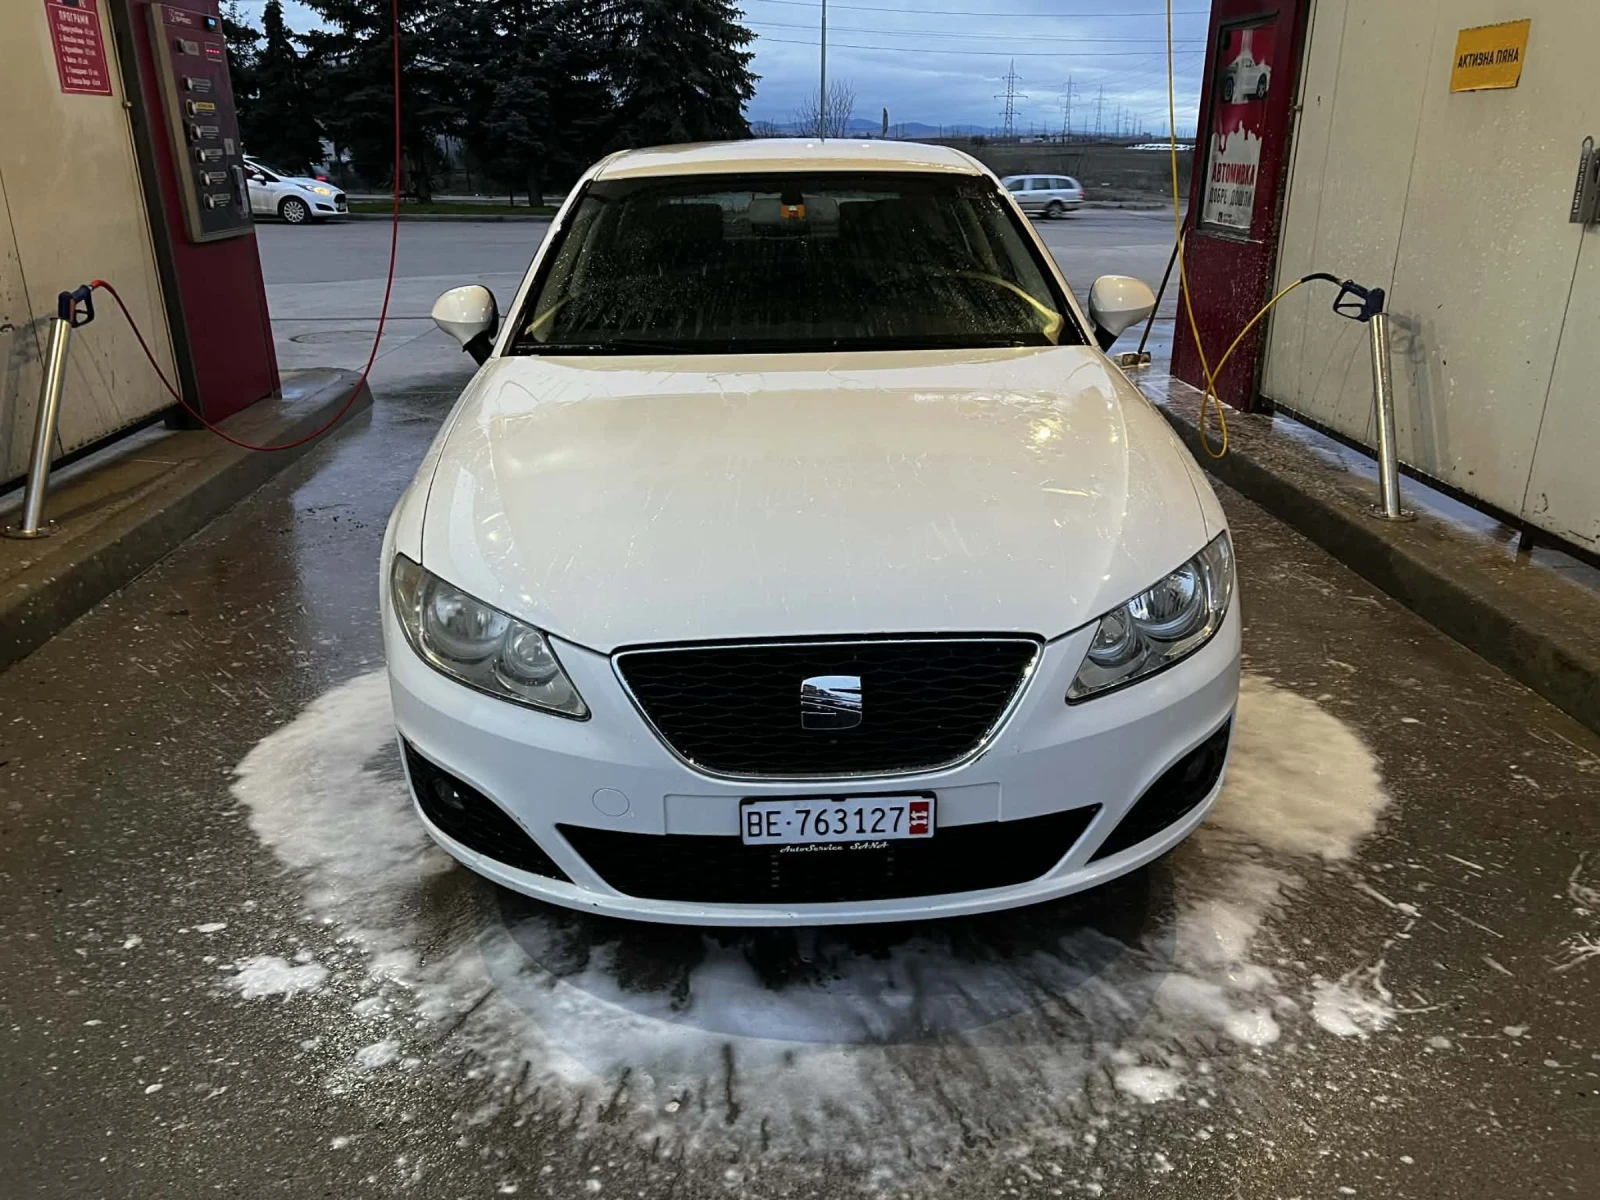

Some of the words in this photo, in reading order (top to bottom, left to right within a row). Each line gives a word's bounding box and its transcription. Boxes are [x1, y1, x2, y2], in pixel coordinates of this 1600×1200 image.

[58, 10, 89, 25] ПРОГРАМИ
[1457, 51, 1495, 69] АКТИВНА
[1495, 47, 1519, 65] ПЯНА
[1212, 163, 1255, 185] АВТОМИВКА
[1208, 186, 1228, 205] ДОБРЕ
[780, 844, 843, 853] AutoService
